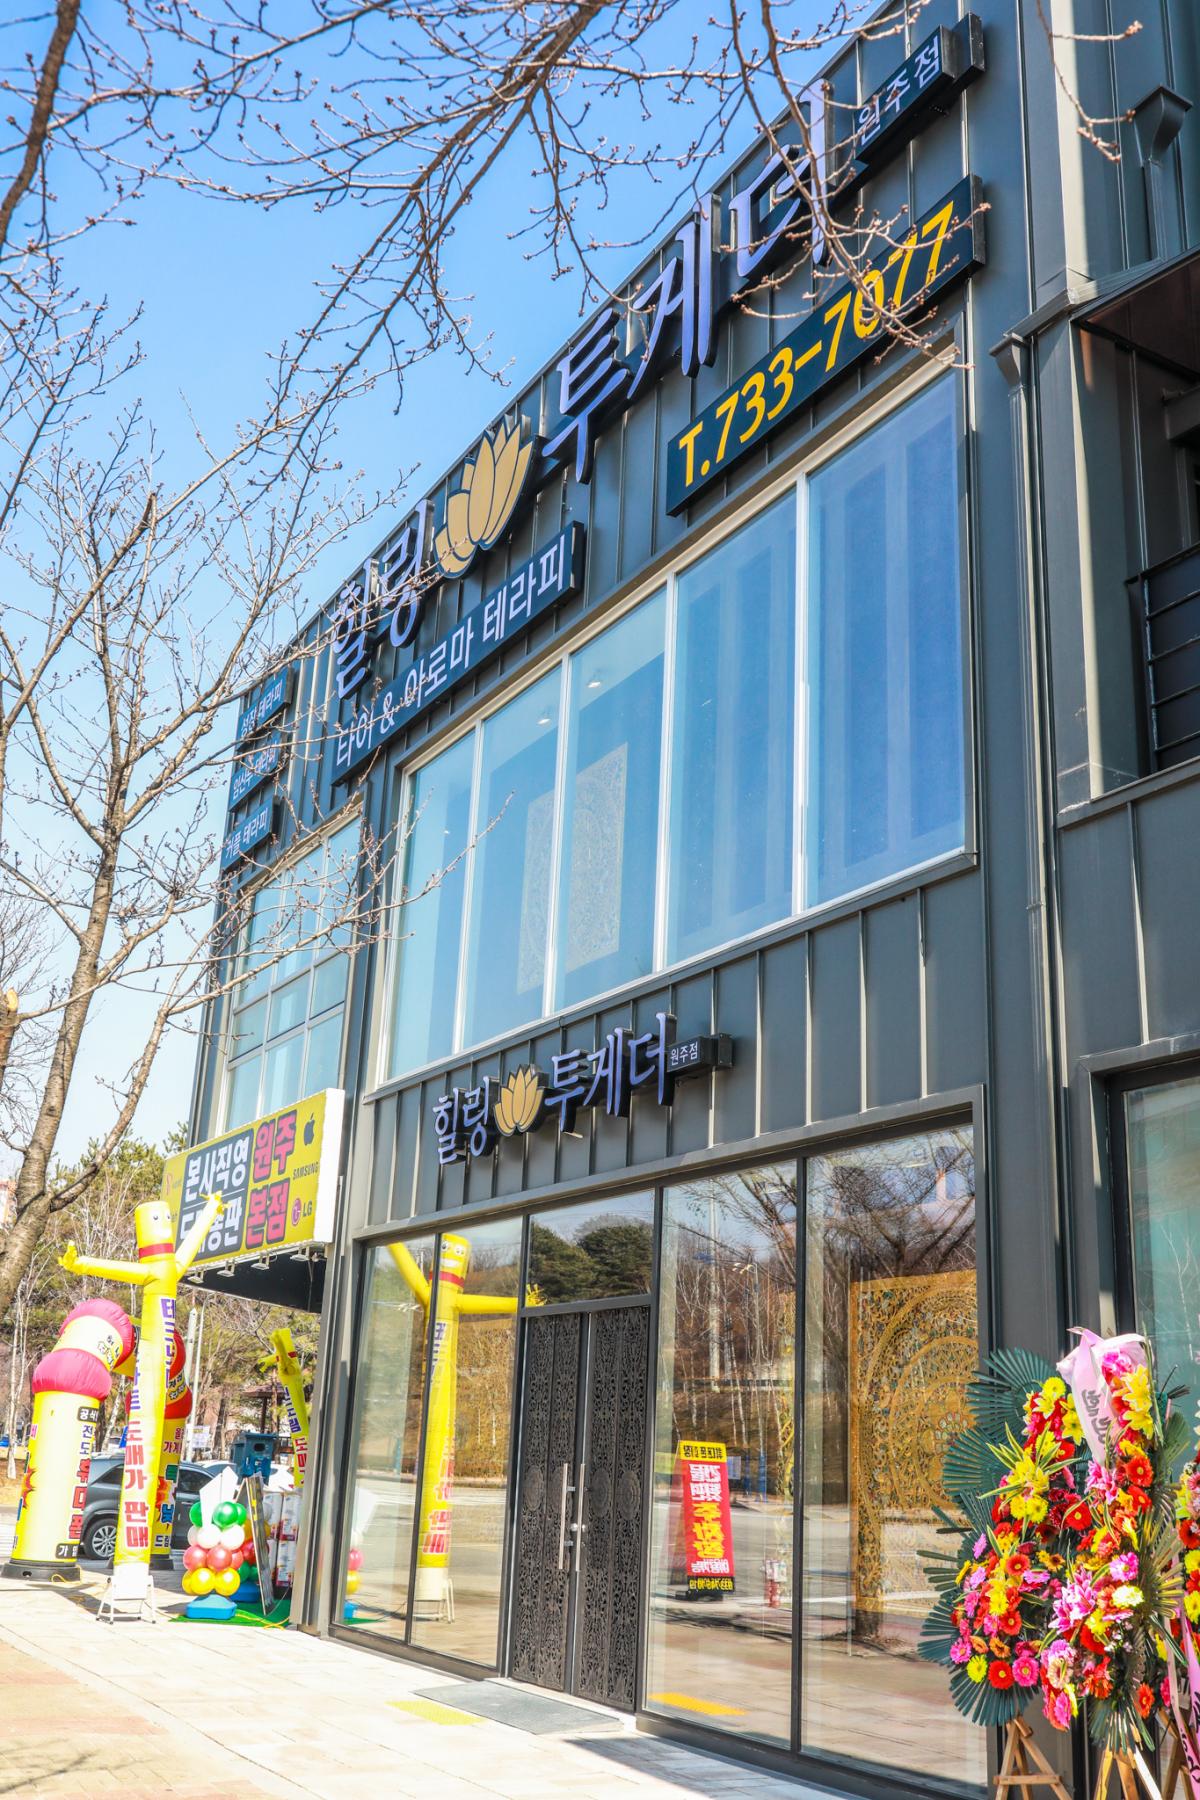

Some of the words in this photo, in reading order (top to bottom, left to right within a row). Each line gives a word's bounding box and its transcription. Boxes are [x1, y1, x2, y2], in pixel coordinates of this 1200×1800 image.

[331, 499, 428, 699] 힐링
[541, 78, 827, 484] 투게더
[857, 35, 940, 146] 원주점
[336, 708, 375, 768] 타이
[379, 691, 396, 735] &
[404, 616, 475, 708] 아로마
[482, 534, 566, 643] 테라피
[258, 678, 283, 720] 테라피
[242, 807, 269, 846] 테라피
[433, 1075, 490, 1165] 힐링
[544, 1012, 667, 1132] 투게더
[670, 1041, 699, 1067] 원주점
[184, 1135, 250, 1204] 본사직영
[253, 1110, 298, 1183] 원주
[292, 1161, 320, 1181] SAMSUNG
[246, 1179, 290, 1248] 본점
[303, 1199, 313, 1217] LG
[123, 1500, 149, 1549] 판매
